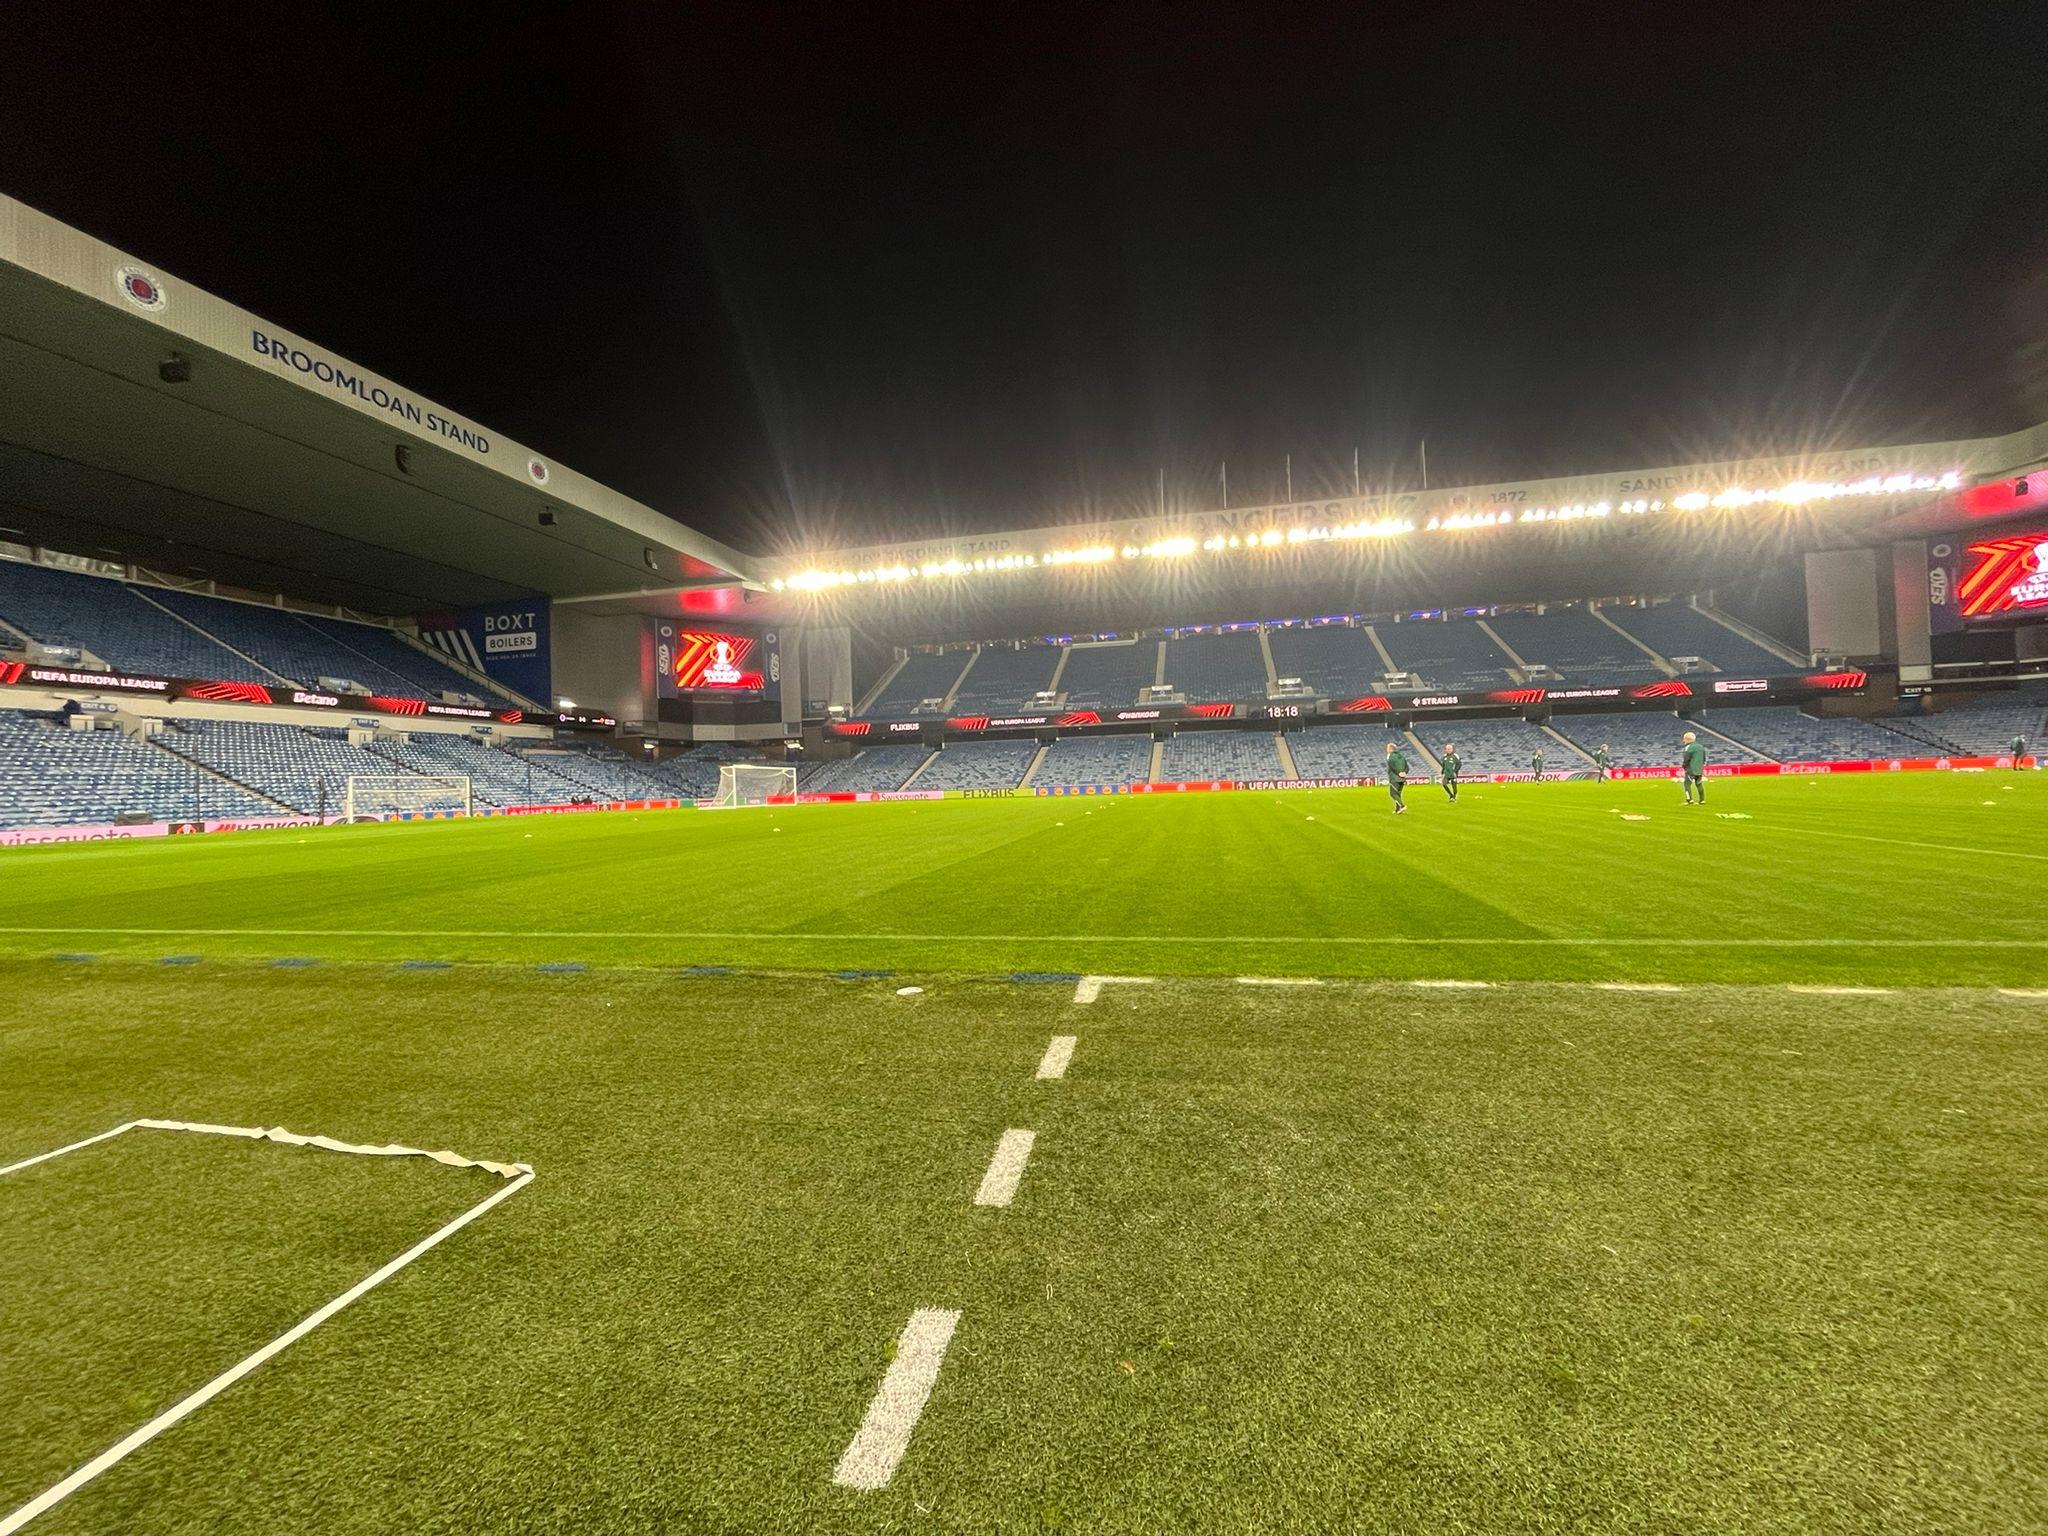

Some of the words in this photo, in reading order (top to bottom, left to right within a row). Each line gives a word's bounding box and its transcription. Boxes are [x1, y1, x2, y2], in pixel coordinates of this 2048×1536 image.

[252, 330, 421, 426] BROOMLOAN
[426, 412, 490, 454] STAND
[1490, 490, 1527, 504] 1872
[1929, 567, 1949, 606] SEKO
[485, 612, 536, 632] BOXT
[490, 636, 533, 649] BOILERS
[658, 644, 670, 675] SEKO
[770, 652, 781, 682] SEKO
[31, 670, 69, 683] UEFA
[69, 673, 121, 687] EUROPA
[120, 678, 168, 691] LEAGUE
[293, 691, 339, 707] Betano
[1421, 696, 1459, 706] STRAUSS
[1267, 705, 1299, 719] 18:18
[1628, 769, 1672, 779] STRAUSS
[1780, 762, 1832, 775] Betano
[1249, 782, 1276, 791] UEFA
[1276, 780, 1317, 790] EUROPA
[1318, 778, 1360, 788] LEAGUE
